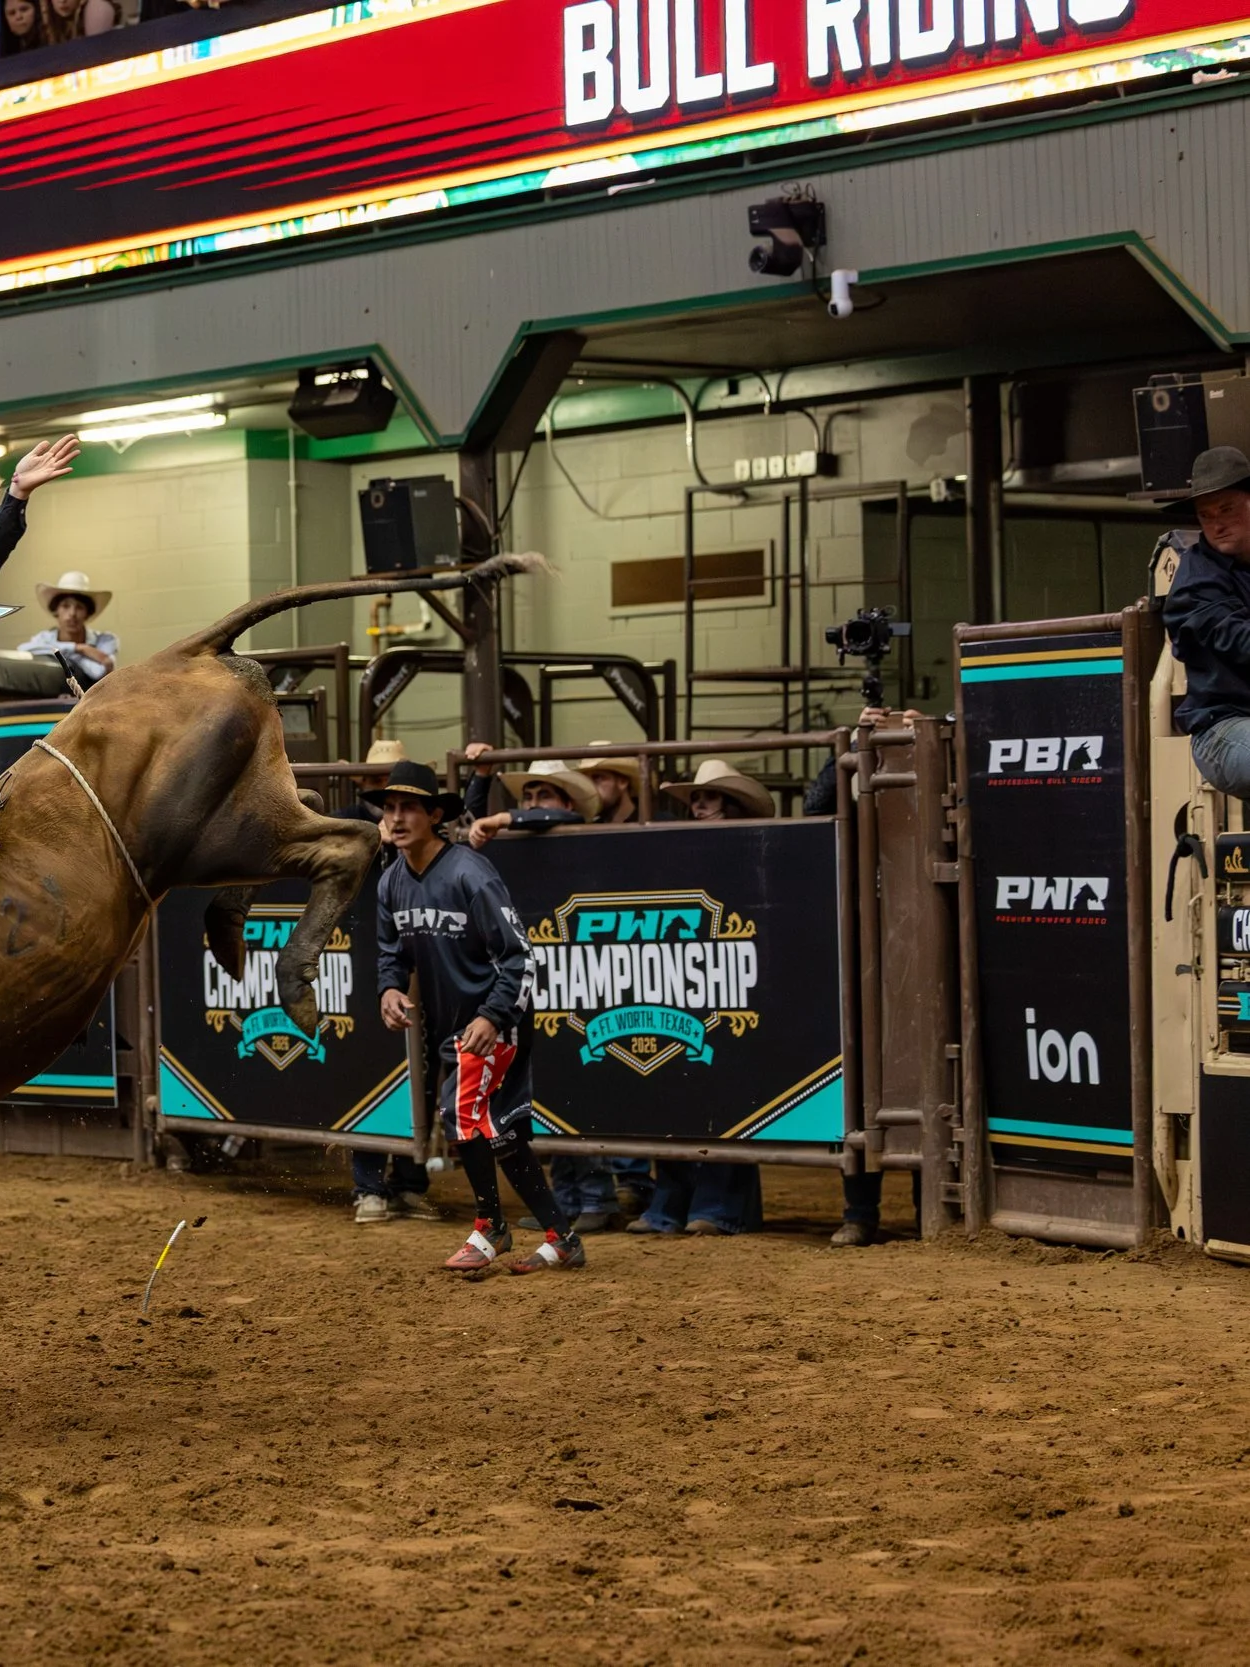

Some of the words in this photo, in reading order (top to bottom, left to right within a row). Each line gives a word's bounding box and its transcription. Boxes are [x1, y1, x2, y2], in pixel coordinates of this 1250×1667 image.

[563, 0, 775, 126] BULL
[807, 0, 1132, 78] RID
[988, 736, 1104, 774] PBR
[988, 778, 1044, 787] PROFESSIONAL
[1046, 777, 1067, 786] BULL
[1071, 776, 1103, 785] RIDERS
[995, 876, 1110, 911] PWR
[243, 921, 300, 948] PW
[576, 908, 703, 942] PWR
[203, 950, 354, 1014] CHAMPIHIP
[531, 941, 759, 1010] CHAMPIONSHIP
[598, 1016, 615, 1034] FT.
[614, 1010, 657, 1031] WORTH,
[659, 1011, 693, 1036] TEXAS
[631, 1036, 658, 1053] 2026
[1025, 1007, 1100, 1085] ion
